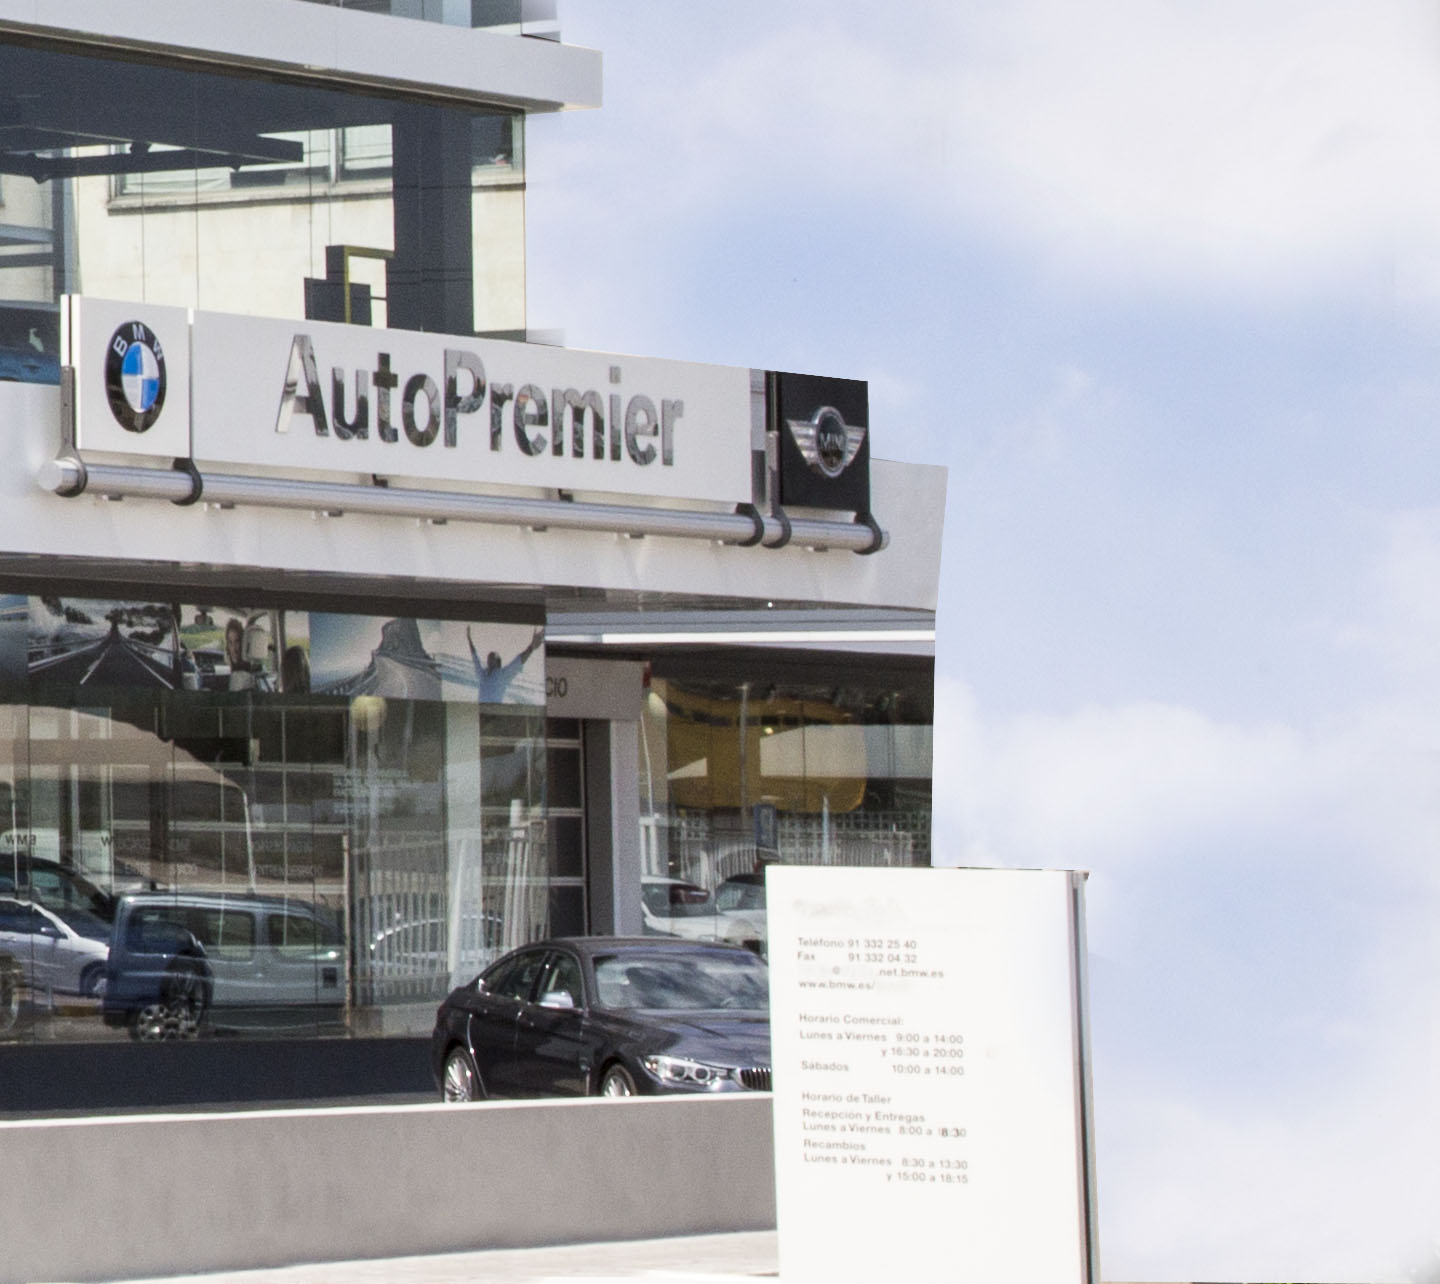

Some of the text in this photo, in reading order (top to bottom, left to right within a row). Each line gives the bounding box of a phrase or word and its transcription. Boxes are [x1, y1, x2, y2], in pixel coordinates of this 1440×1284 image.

[113, 323, 164, 360] BMW
[274, 333, 684, 467] AutoPremier
[848, 939, 860, 948] 91
[864, 939, 883, 949] 332
[888, 940, 900, 949] 25
[904, 940, 917, 950] 40
[797, 951, 917, 963] Fax 91 332 04 32
[799, 1013, 904, 1026] Horario Comercial:
[800, 1030, 833, 1040] Lunes
[844, 1031, 887, 1042] Viernes
[896, 1034, 920, 1042] 9:00
[934, 1034, 964, 1044] 14:00
[892, 1048, 920, 1056] 16:30
[933, 1048, 964, 1058] 20:00
[892, 1064, 921, 1074] 10:00
[935, 1066, 964, 1076] 14:00
[802, 1092, 892, 1104] Horario de Taller
[874, 1112, 925, 1124] Entregas
[802, 1122, 836, 1132] Lunes
[848, 1124, 891, 1134] Viernes
[803, 1138, 866, 1150] Recambios
[804, 1153, 838, 1163] Lunes
[849, 1155, 892, 1166] Viernes
